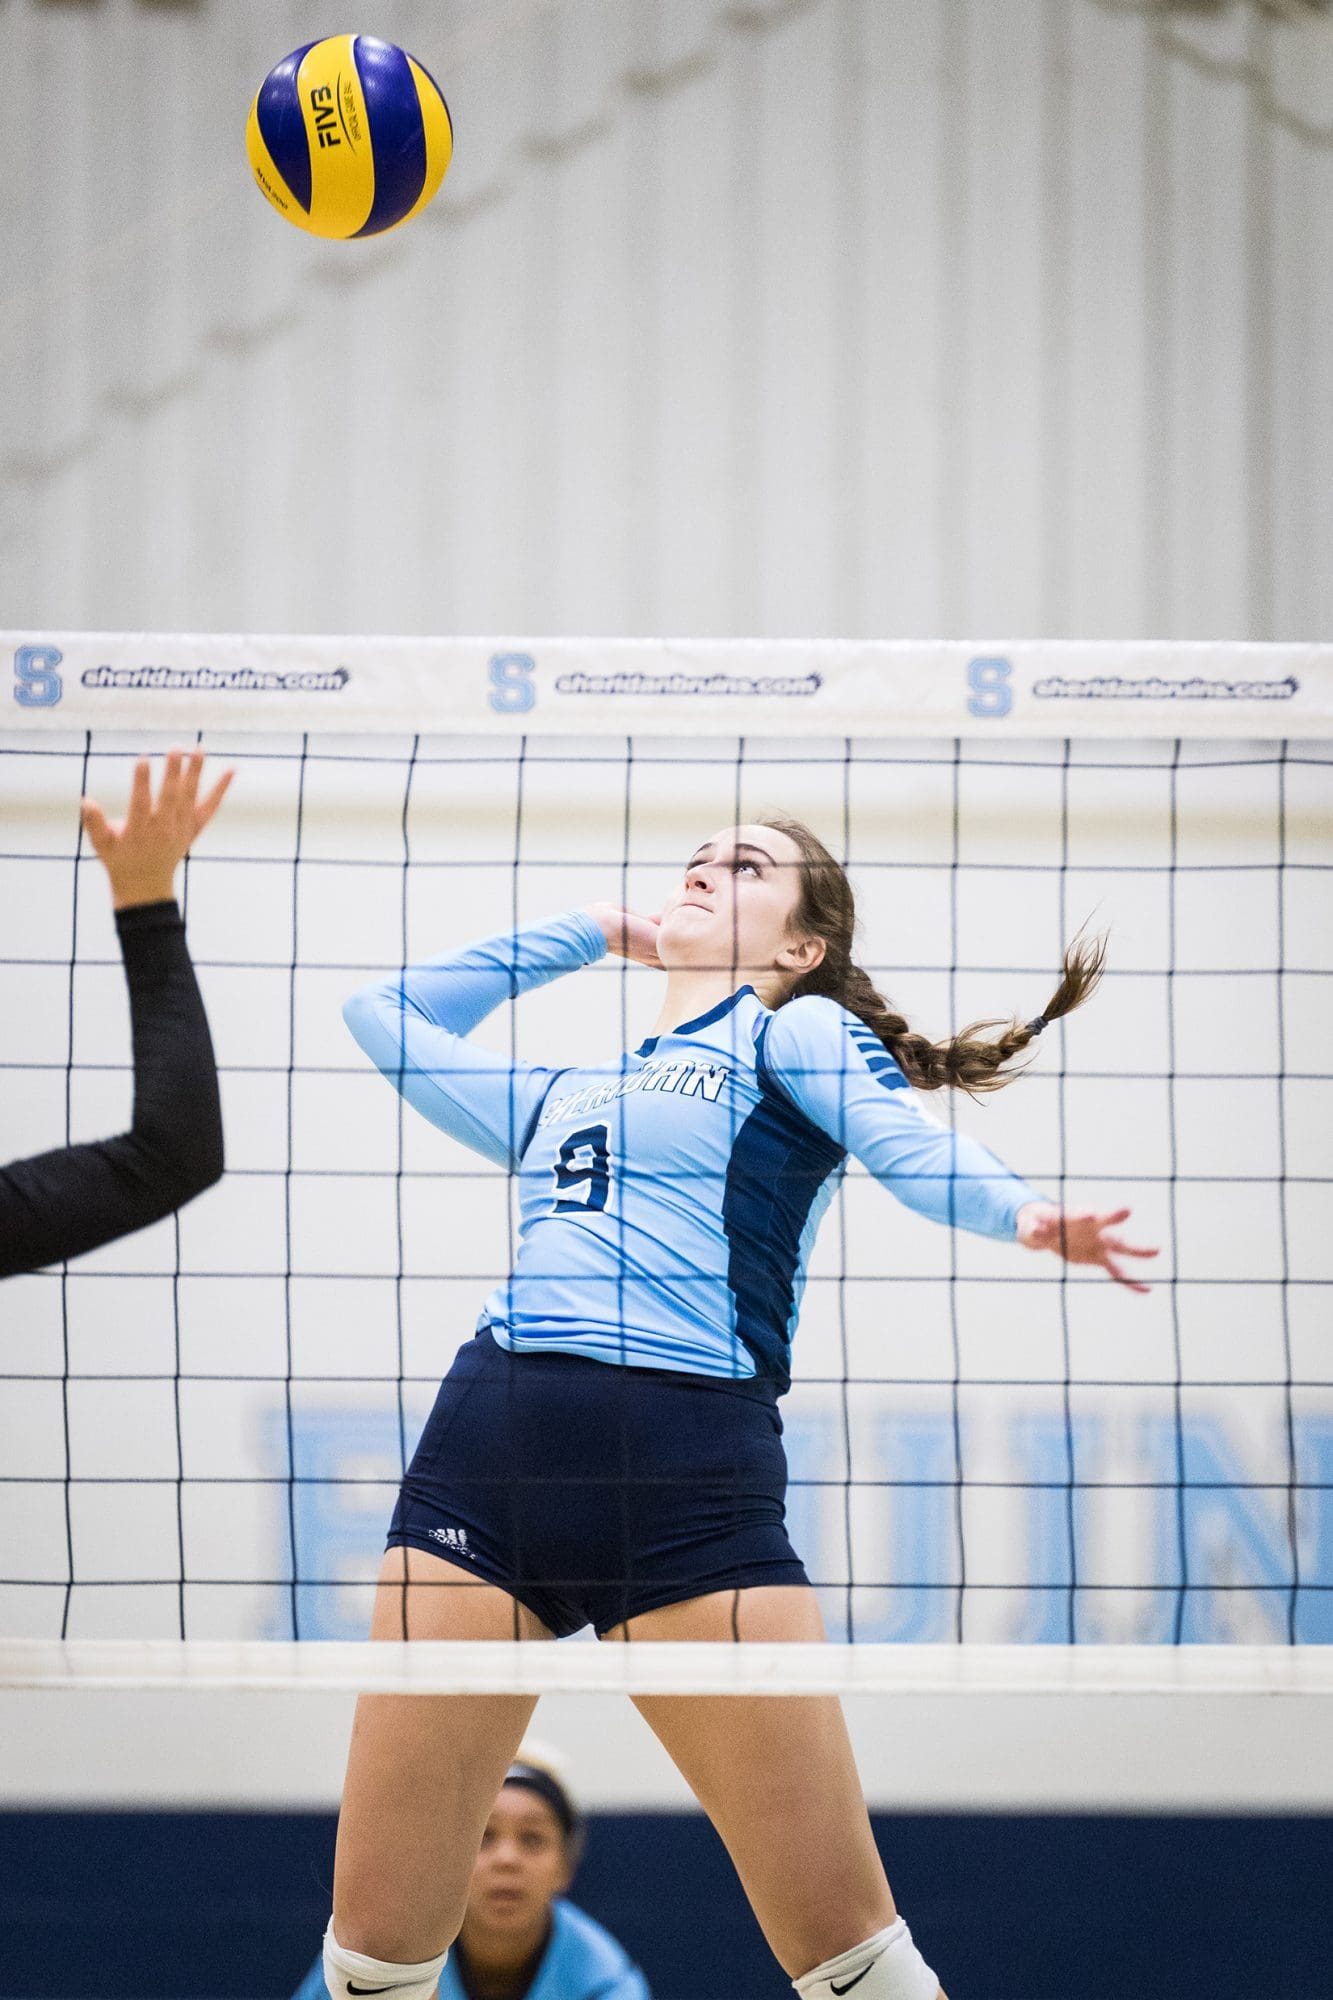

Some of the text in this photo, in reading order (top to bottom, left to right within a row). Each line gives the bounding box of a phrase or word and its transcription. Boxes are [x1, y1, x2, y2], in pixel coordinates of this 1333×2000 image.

[13, 645, 350, 708] S sheridanbruins.com
[488, 653, 822, 714] S sheridanbruins.com
[967, 657, 1300, 718] S sheridanbruins.com
[551, 1120, 613, 1215] 9
